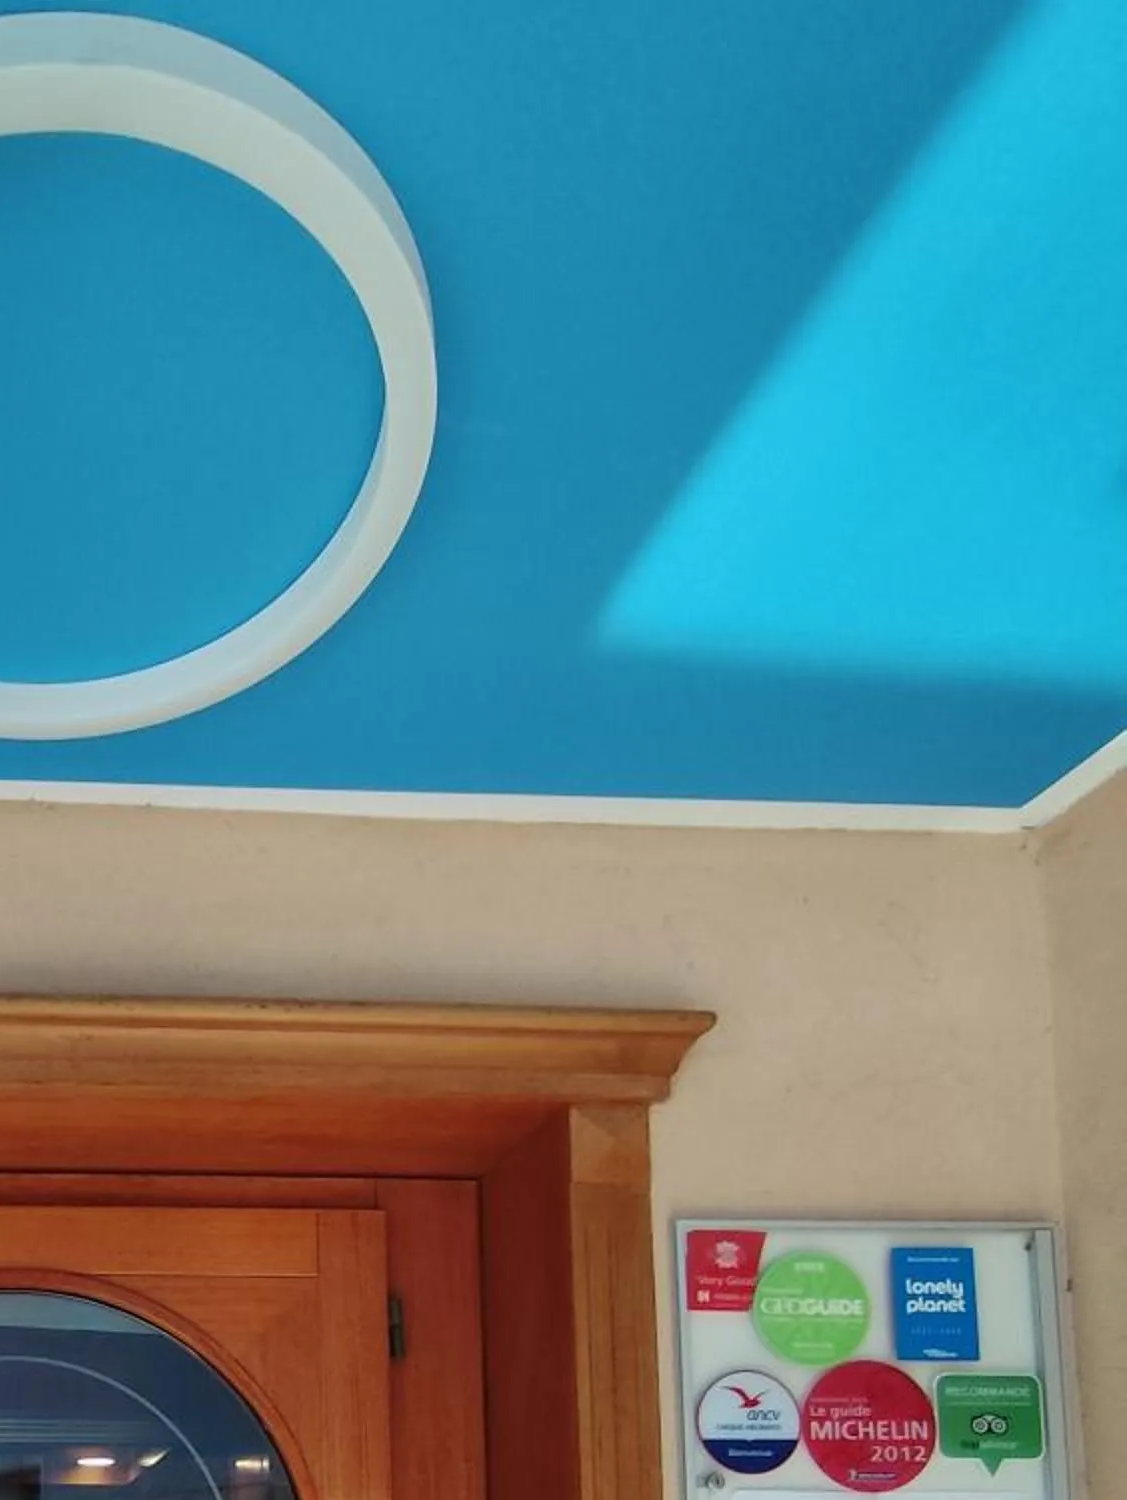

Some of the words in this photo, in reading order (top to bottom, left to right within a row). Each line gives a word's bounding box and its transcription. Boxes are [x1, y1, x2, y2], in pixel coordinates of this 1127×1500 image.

[905, 1277, 964, 1298] lonely
[906, 1296, 966, 1315] planet
[809, 1406, 827, 1417] Le
[830, 1405, 871, 1420] guide
[810, 1420, 928, 1441] MICHELIN
[871, 1445, 926, 1462] 2012
